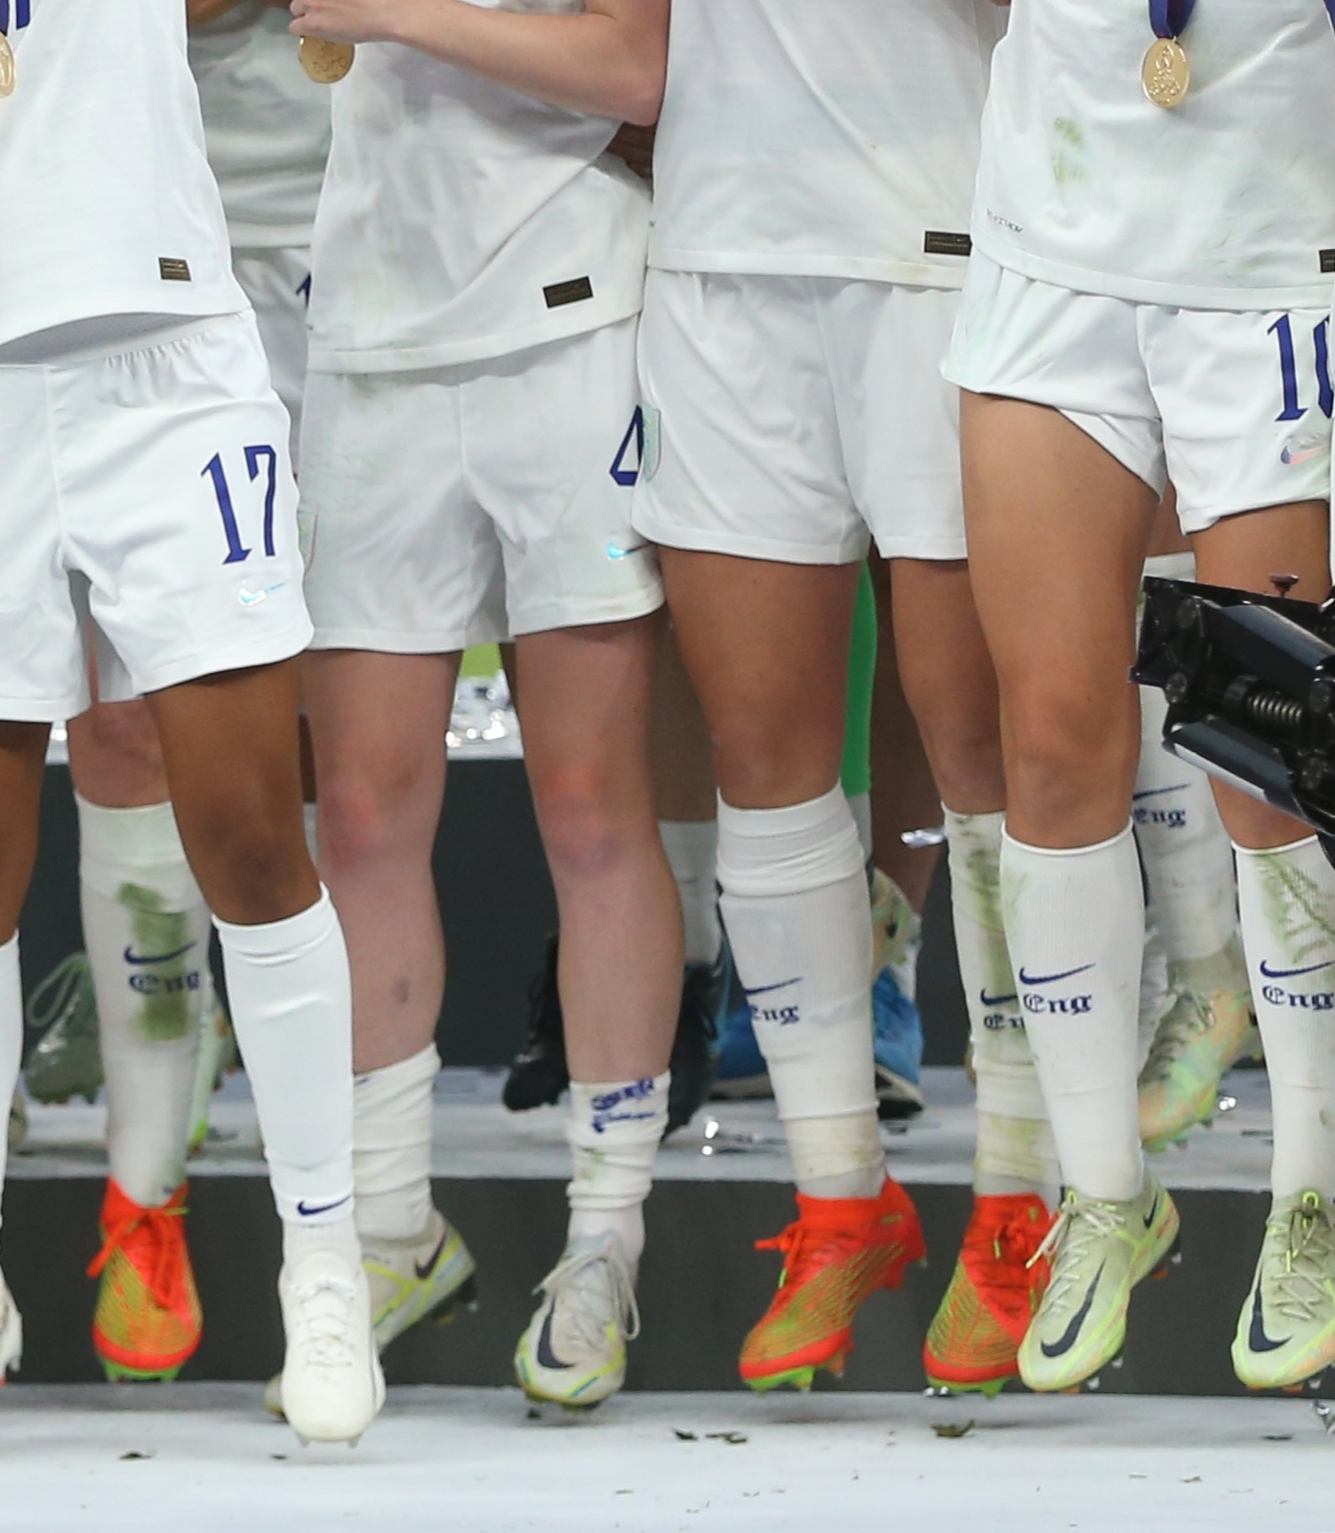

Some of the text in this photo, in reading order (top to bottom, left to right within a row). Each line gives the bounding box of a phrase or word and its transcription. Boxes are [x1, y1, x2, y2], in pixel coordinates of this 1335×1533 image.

[200, 443, 278, 565] 17
[1023, 993, 1093, 1017] Eng
[1262, 985, 1335, 1011] Eng
